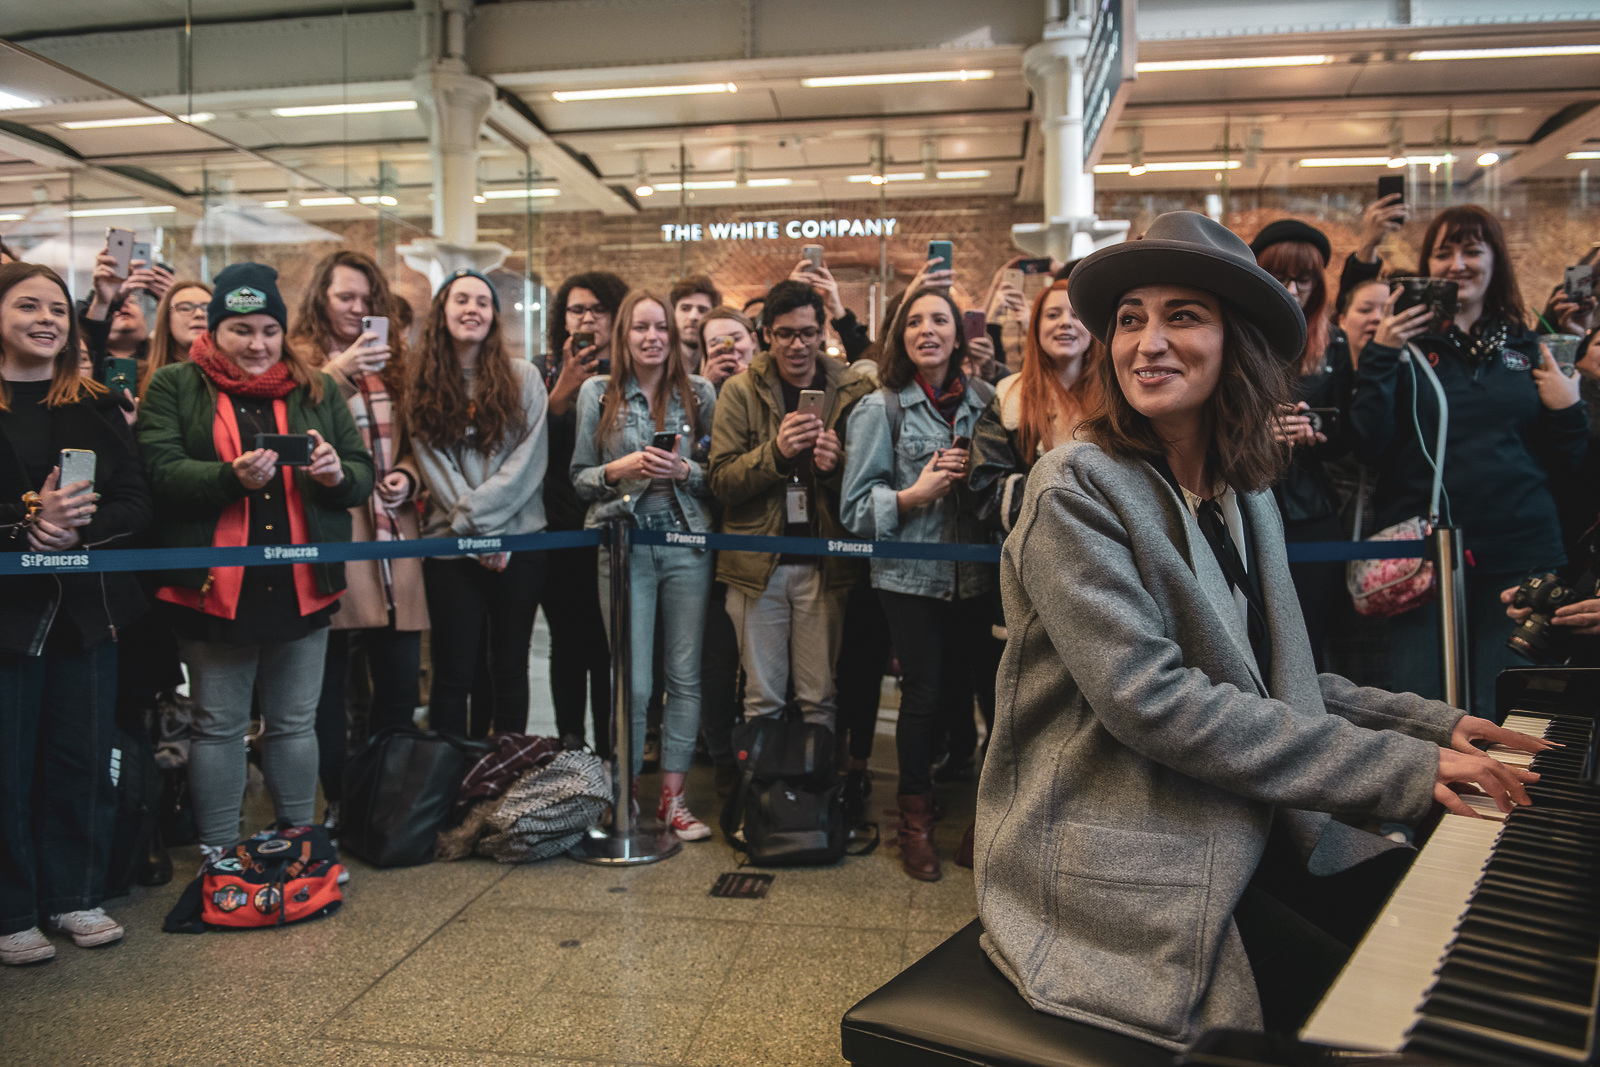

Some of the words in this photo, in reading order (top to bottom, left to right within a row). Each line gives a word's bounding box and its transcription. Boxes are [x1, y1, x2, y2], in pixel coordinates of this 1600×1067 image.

[661, 223, 703, 242] THE
[708, 221, 780, 240] WHITE
[785, 217, 897, 240] COMPANY
